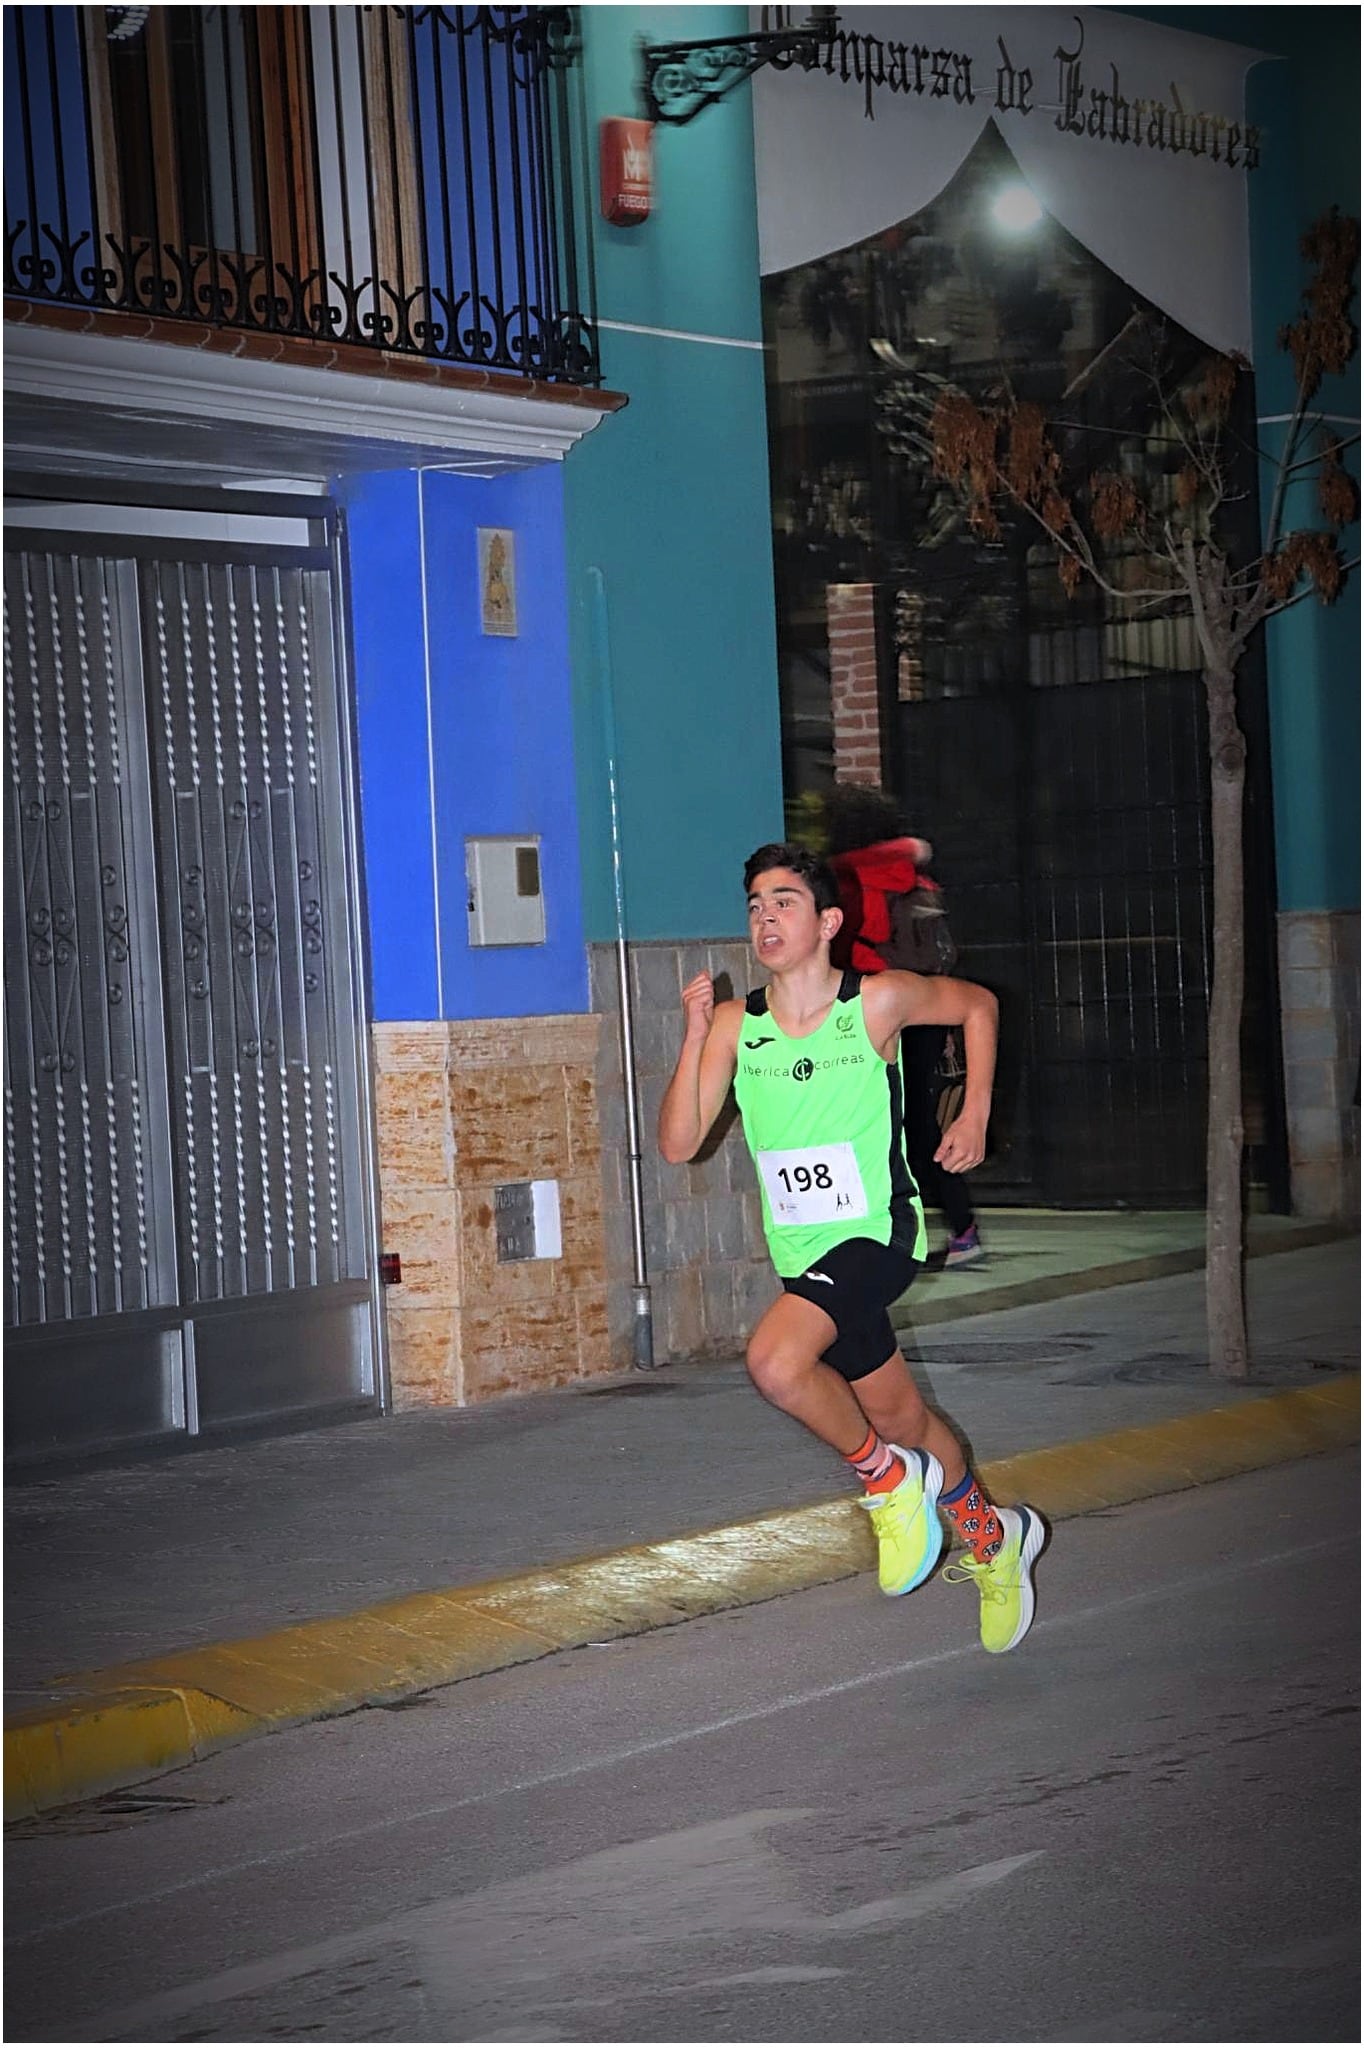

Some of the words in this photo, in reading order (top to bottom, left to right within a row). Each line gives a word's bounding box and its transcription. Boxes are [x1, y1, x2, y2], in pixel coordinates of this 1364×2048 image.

[994, 34, 1034, 116] de
[1053, 15, 1261, 170] Labradores
[814, 1054, 865, 1071] correas
[777, 1163, 833, 1193] 198
